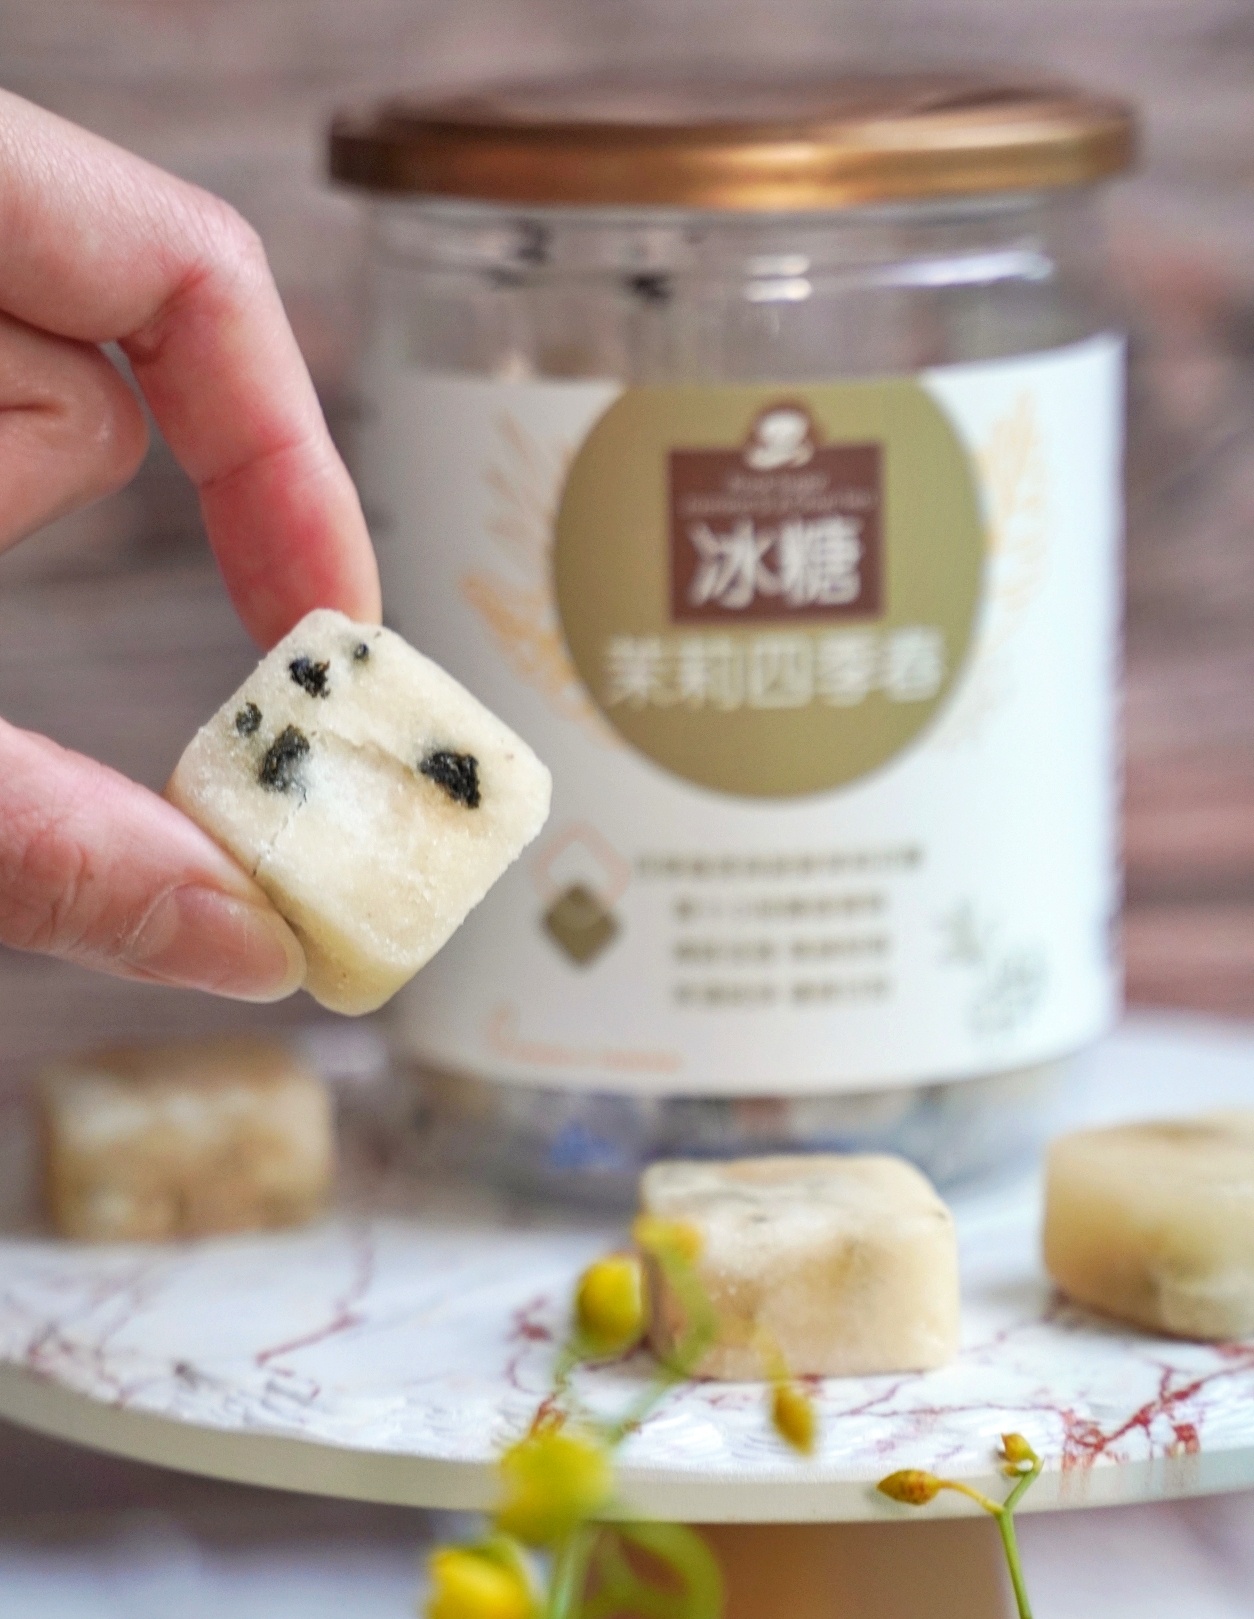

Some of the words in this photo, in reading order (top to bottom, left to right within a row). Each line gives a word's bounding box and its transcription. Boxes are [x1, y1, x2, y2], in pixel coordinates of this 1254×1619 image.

[688, 520, 863, 608] 冰糖
[604, 627, 945, 711] 茉莉四季春
